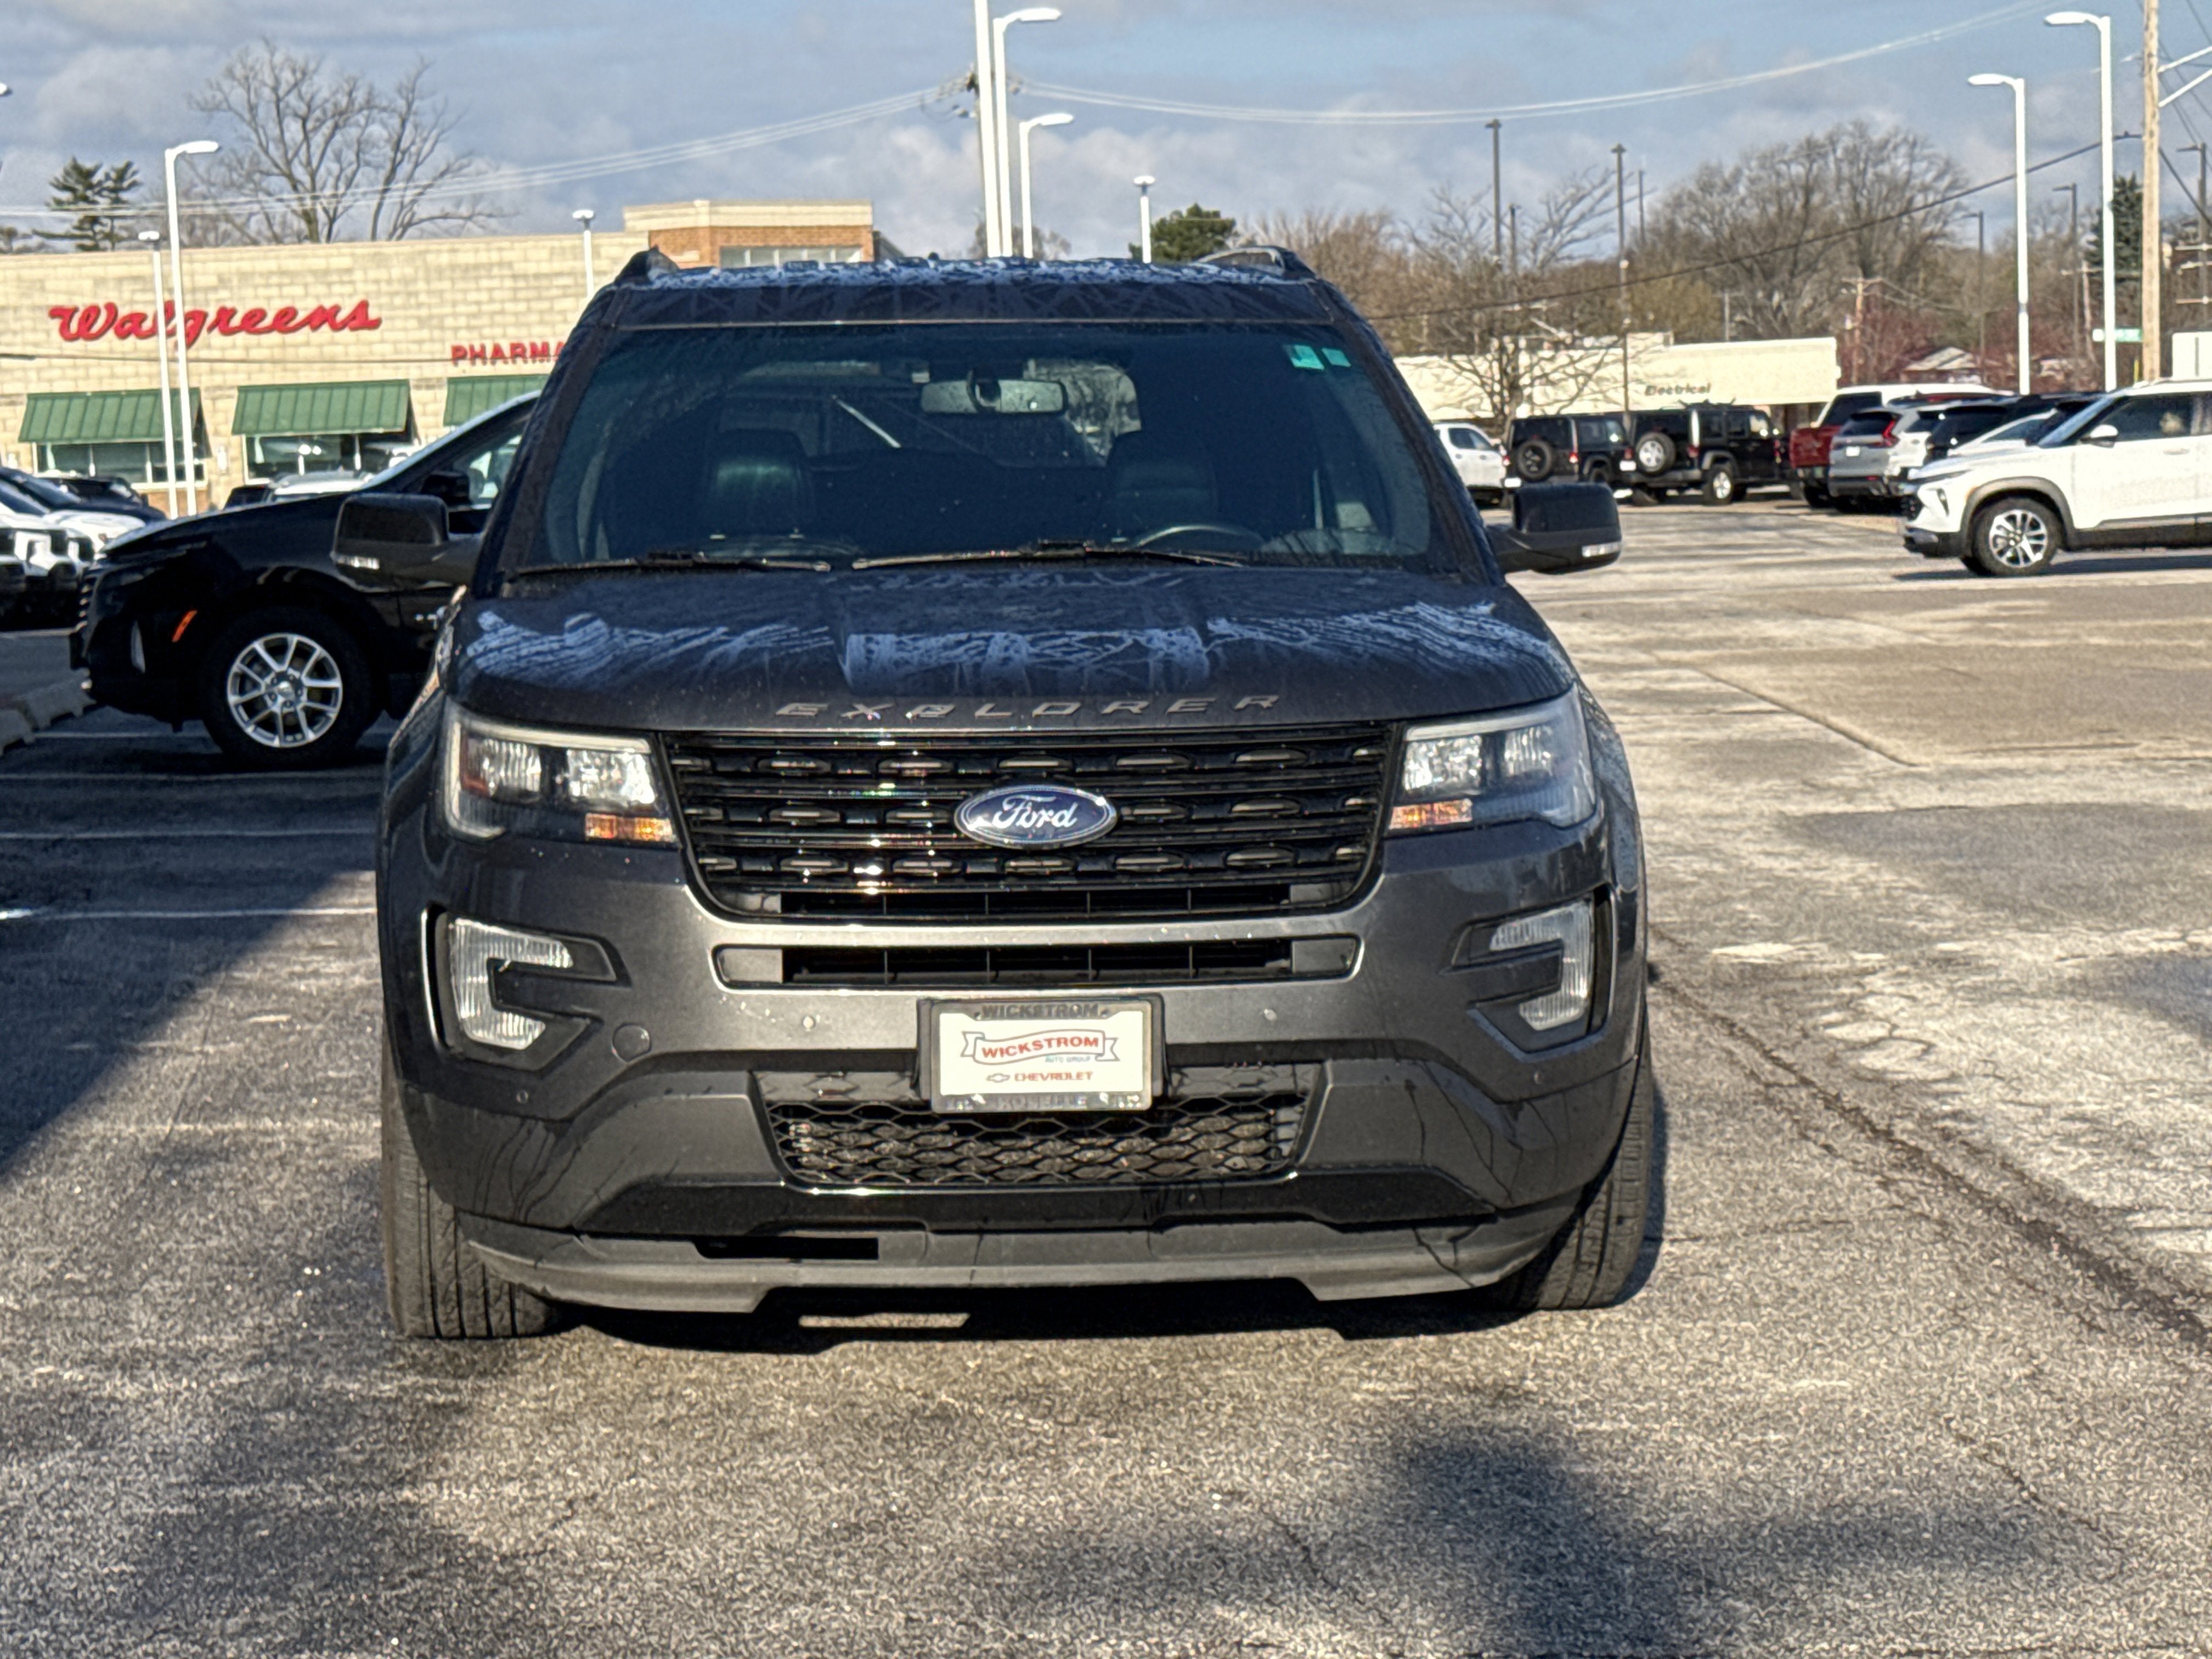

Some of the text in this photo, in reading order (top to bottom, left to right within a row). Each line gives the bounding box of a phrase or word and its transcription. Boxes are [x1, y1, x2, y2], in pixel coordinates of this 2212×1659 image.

[48, 300, 382, 351] Walgreens
[1645, 382, 1711, 396] Electrical
[775, 695, 1280, 719] EXPLORER
[992, 795, 1079, 829] Ford
[982, 1003, 1099, 1019] WICKSTROM
[982, 1036, 1099, 1058] WICKSTROM
[1014, 1071, 1093, 1082] CHEVROLET
